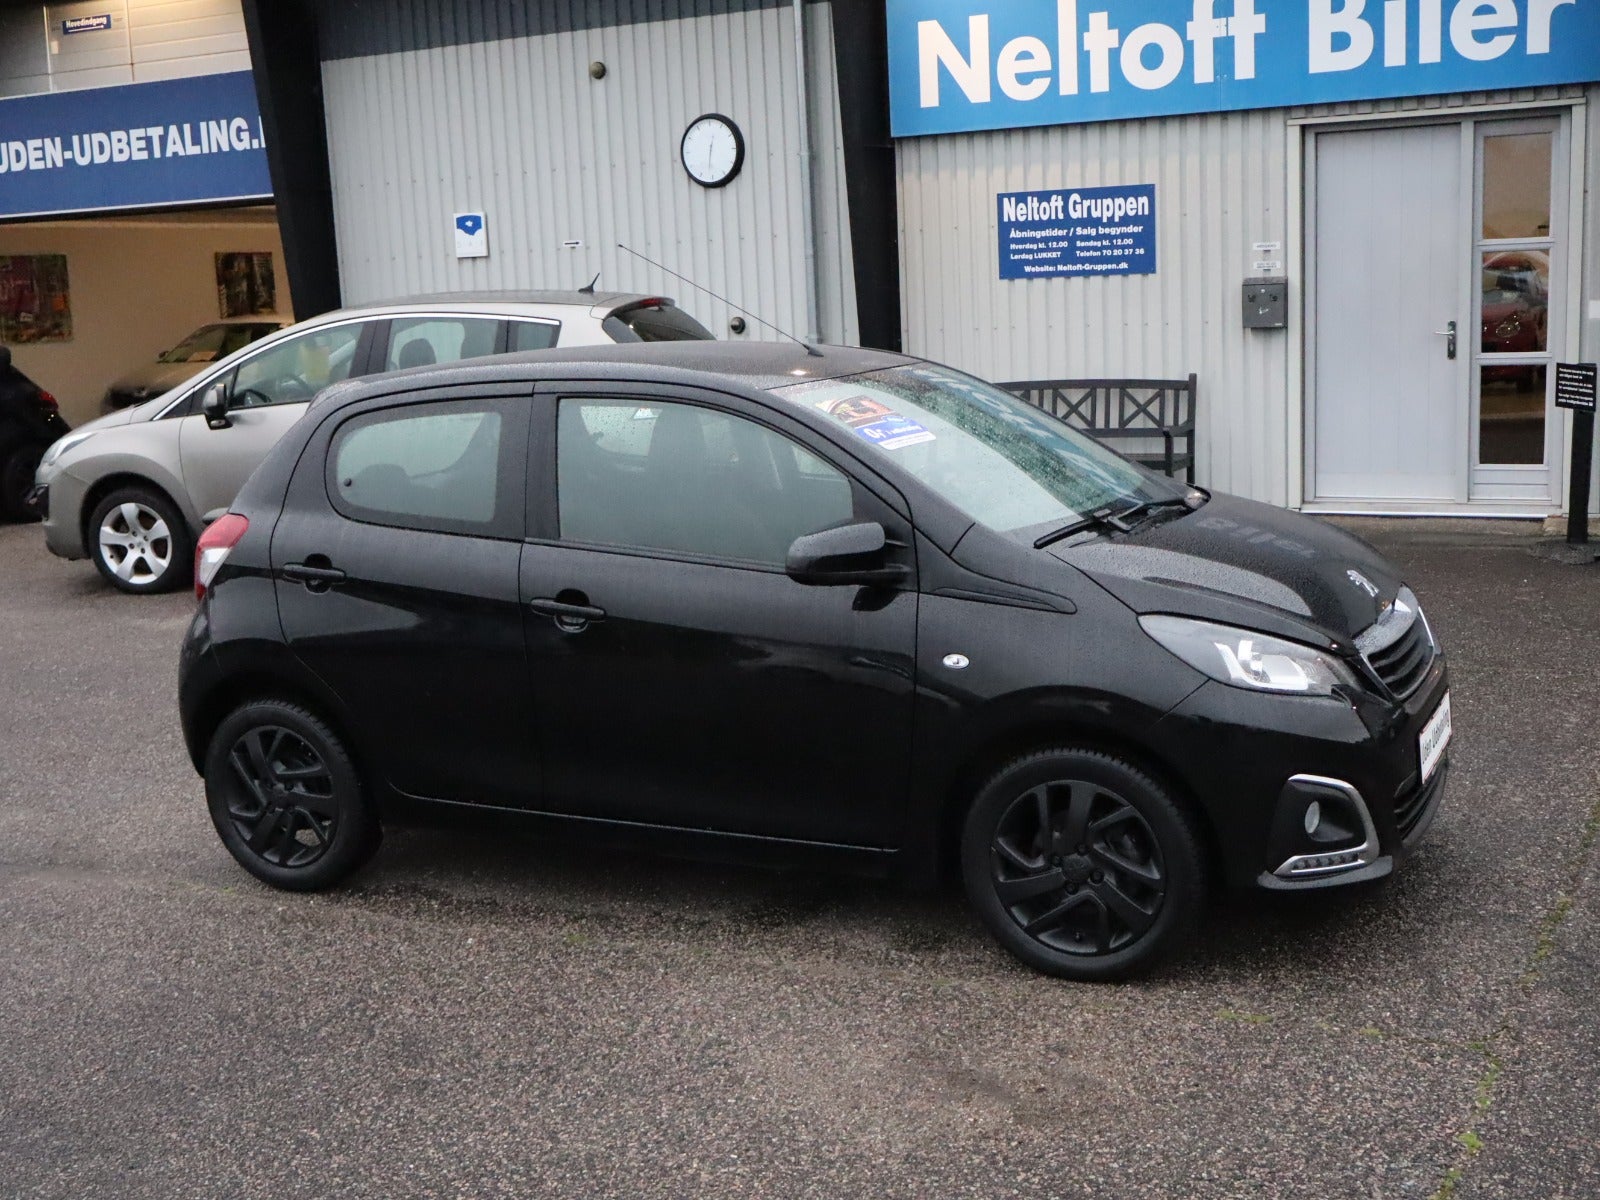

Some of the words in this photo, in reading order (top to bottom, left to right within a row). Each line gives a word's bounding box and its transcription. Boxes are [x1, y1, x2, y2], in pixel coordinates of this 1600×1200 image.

[918, 0, 1266, 108] Neltoft
[1308, 0, 1576, 74] Biler
[1003, 194, 1064, 222] Neltoft
[1068, 193, 1149, 222] Gruppen
[1010, 227, 1068, 239] Åbningstider
[1075, 226, 1097, 236] Salg
[1098, 225, 1144, 236] begynder
[1034, 251, 1062, 259] LUKKET
[1057, 262, 1129, 271] Neltoft-Gruppen.dk
